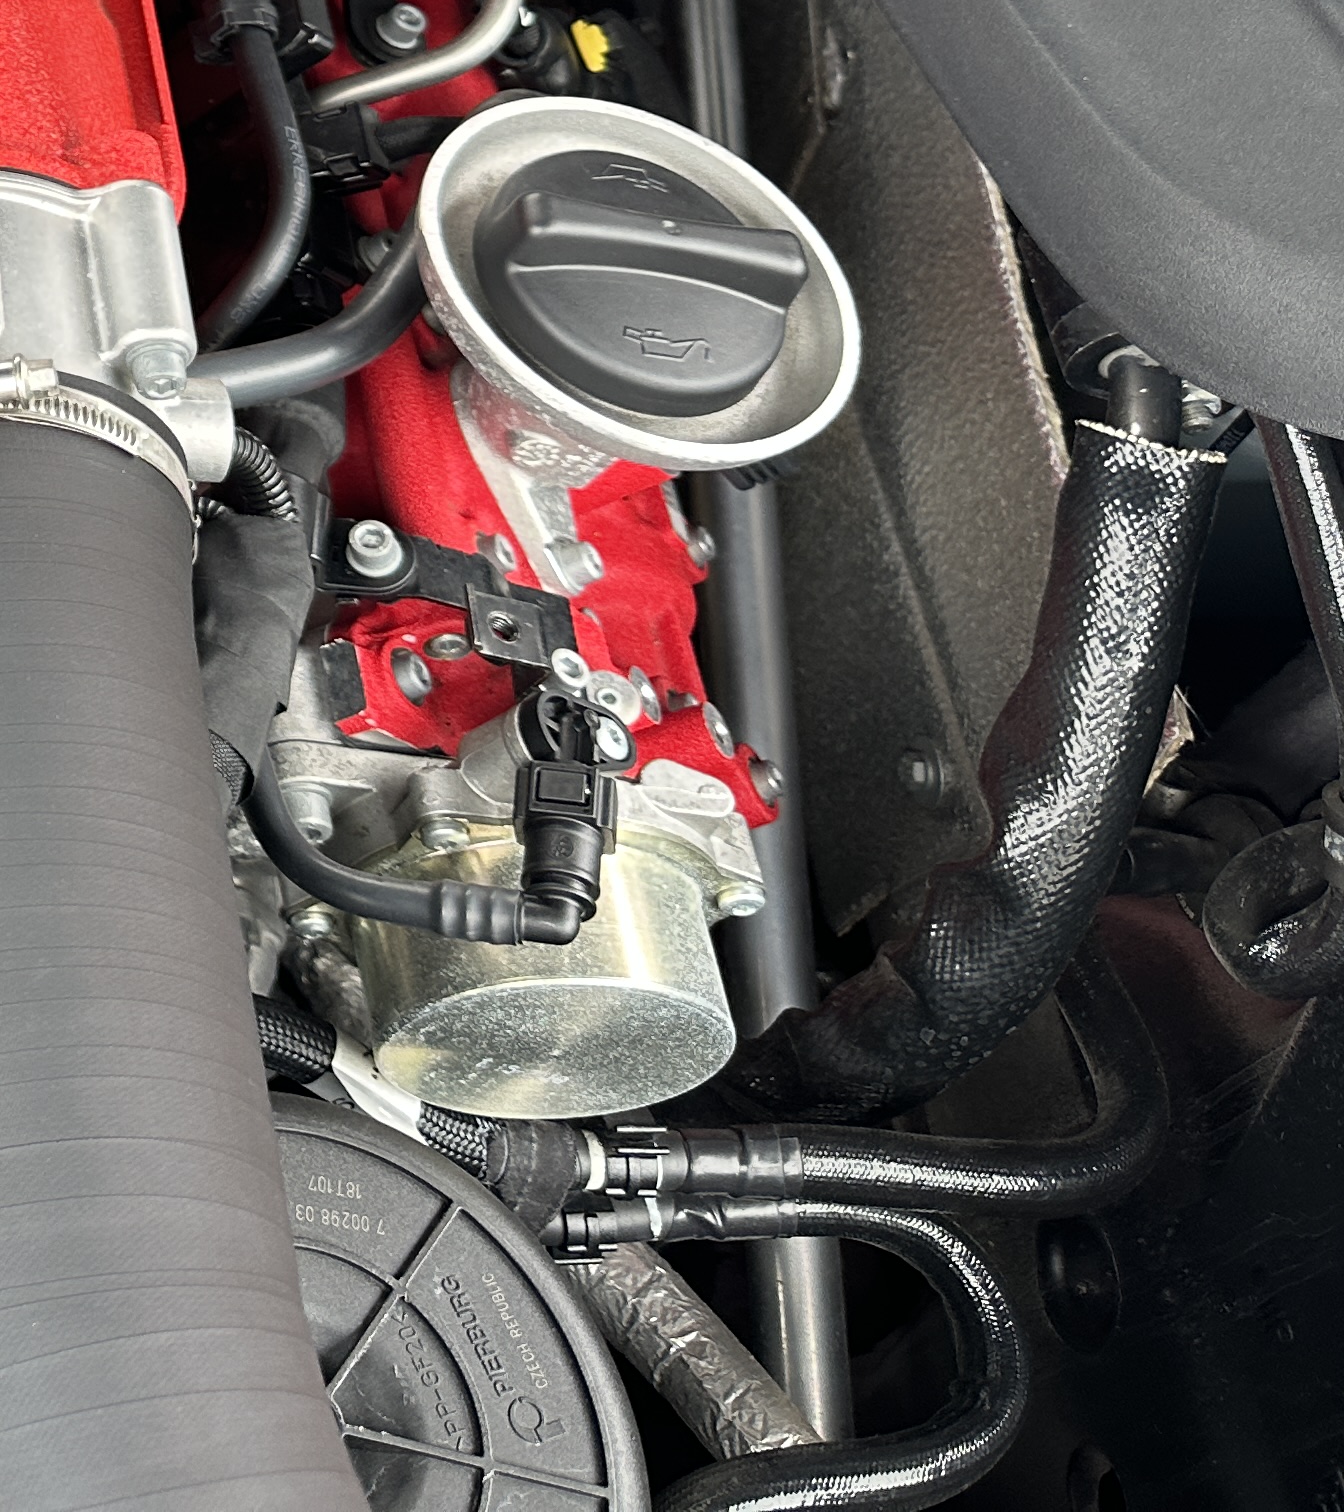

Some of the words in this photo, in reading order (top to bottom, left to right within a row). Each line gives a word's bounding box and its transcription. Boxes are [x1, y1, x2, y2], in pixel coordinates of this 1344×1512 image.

[441, 1274, 514, 1397] PIERBURG
[481, 1272, 523, 1338] REPUBLIC
[517, 1341, 548, 1389] CZECH
